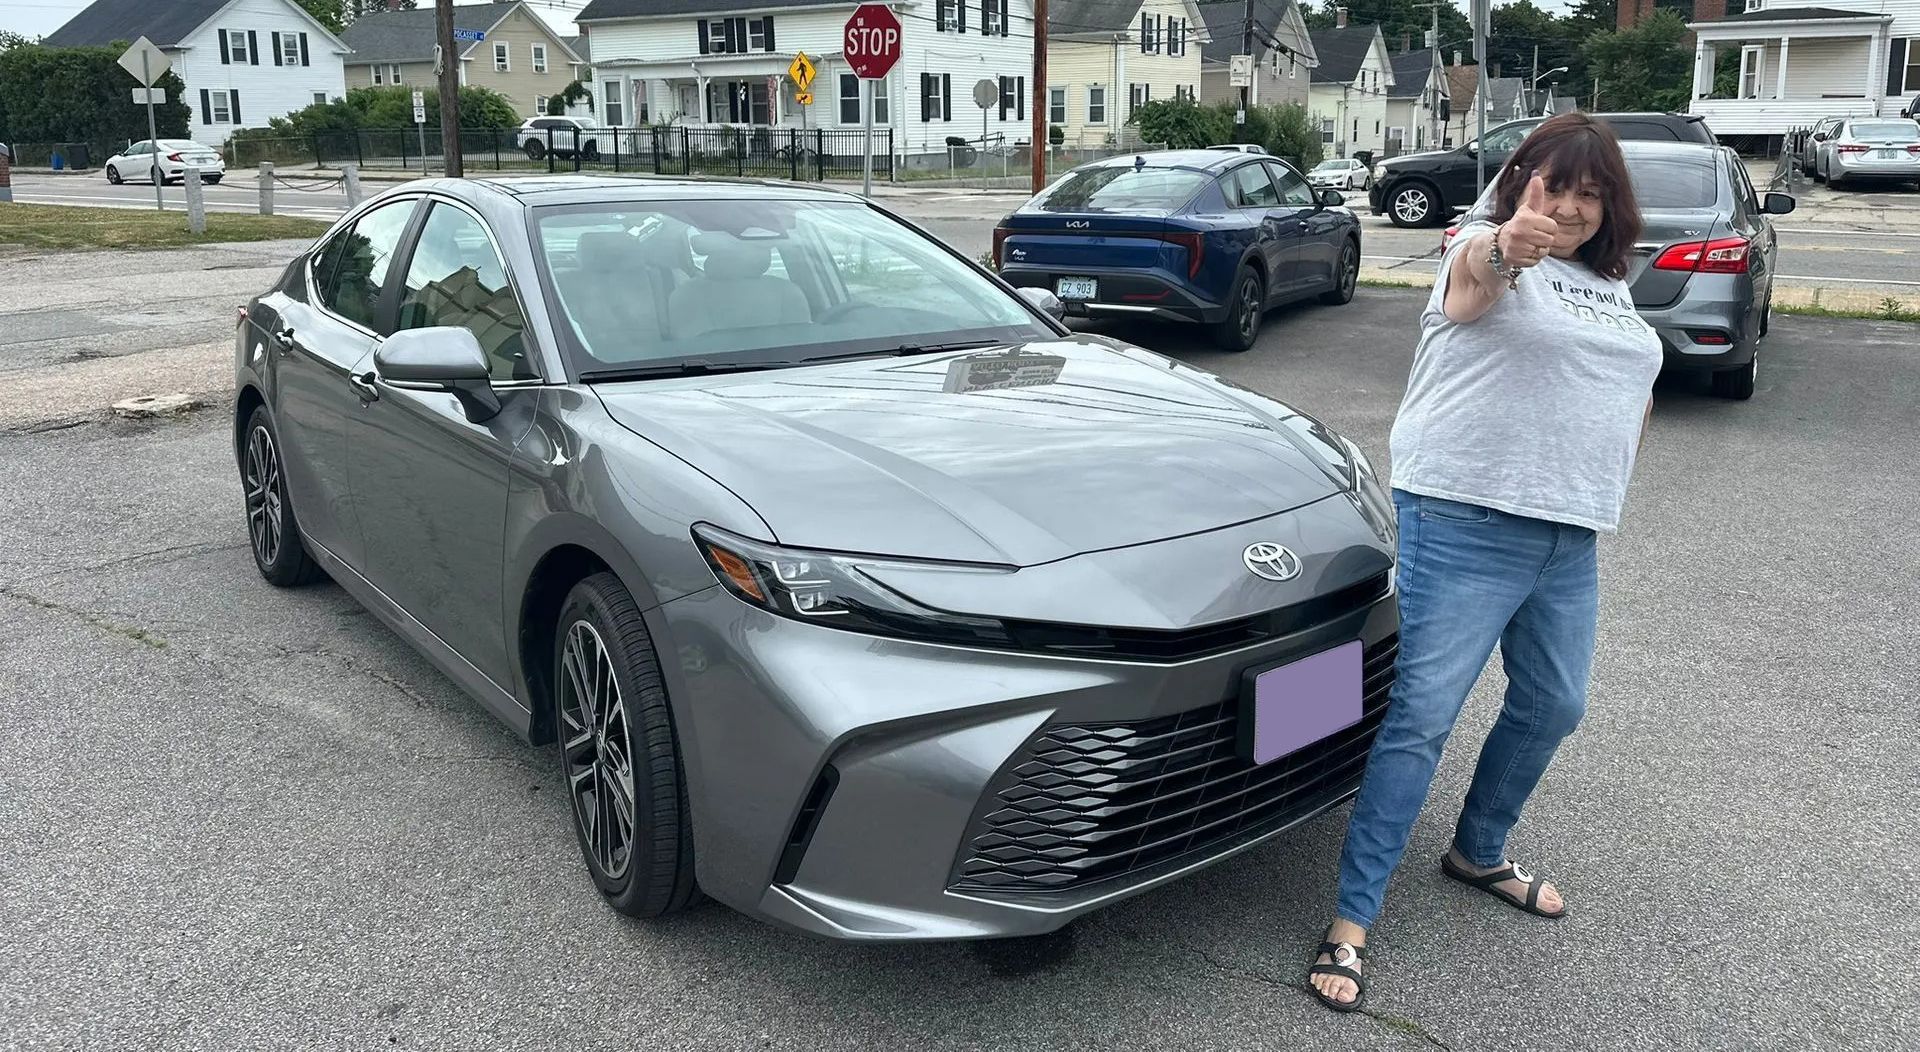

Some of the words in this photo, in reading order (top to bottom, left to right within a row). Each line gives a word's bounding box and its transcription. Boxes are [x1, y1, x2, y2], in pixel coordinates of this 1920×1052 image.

[847, 28, 898, 56] STOP
[1061, 282, 1072, 293] CZ
[1076, 283, 1093, 294] 903
